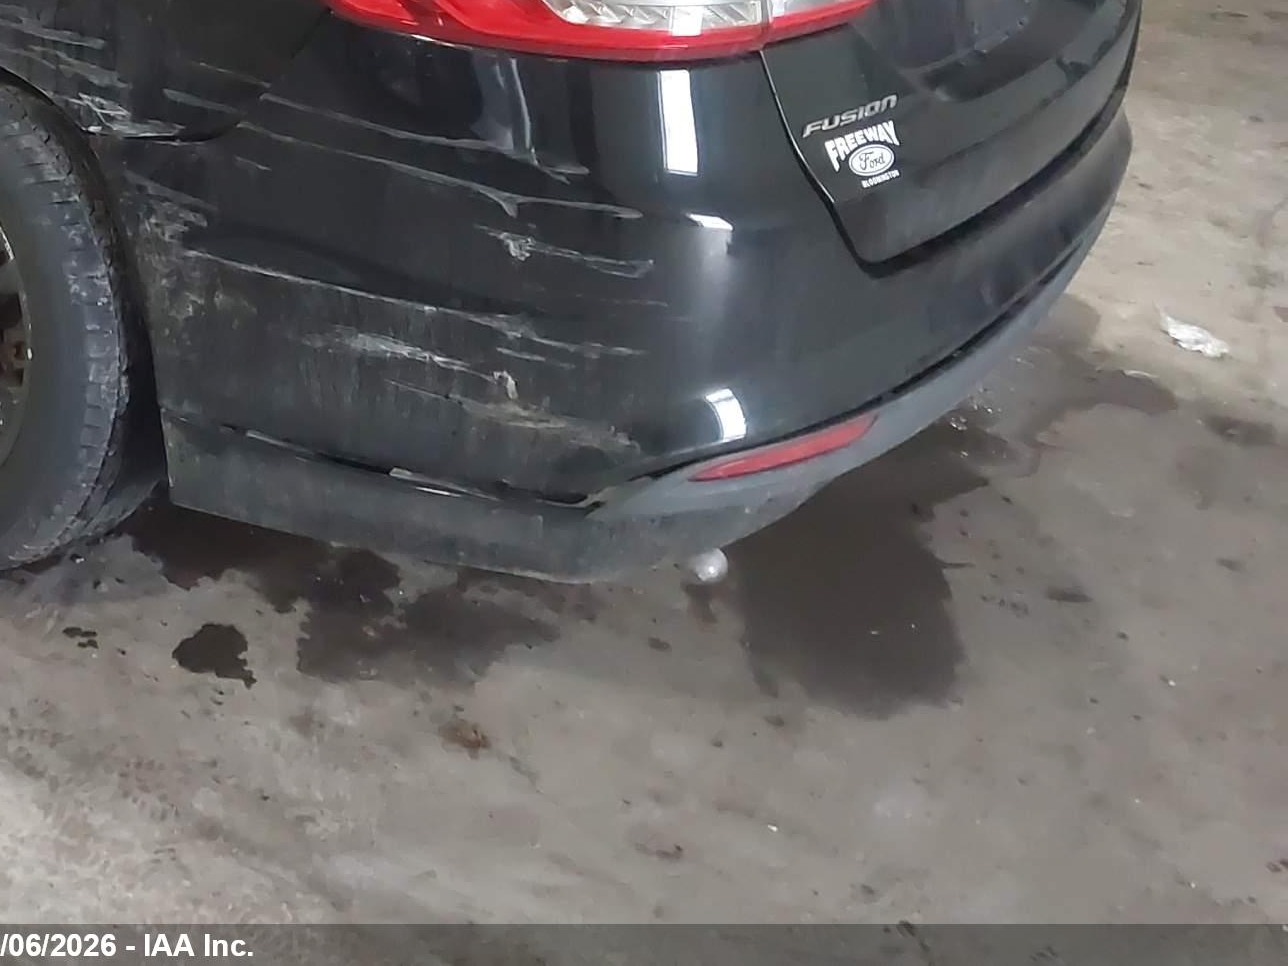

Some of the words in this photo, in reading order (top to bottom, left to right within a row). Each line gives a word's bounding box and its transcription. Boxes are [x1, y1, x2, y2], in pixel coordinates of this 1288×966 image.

[802, 94, 899, 139] FUSION
[824, 119, 901, 173] FREEWAY
[858, 150, 887, 171] Ford
